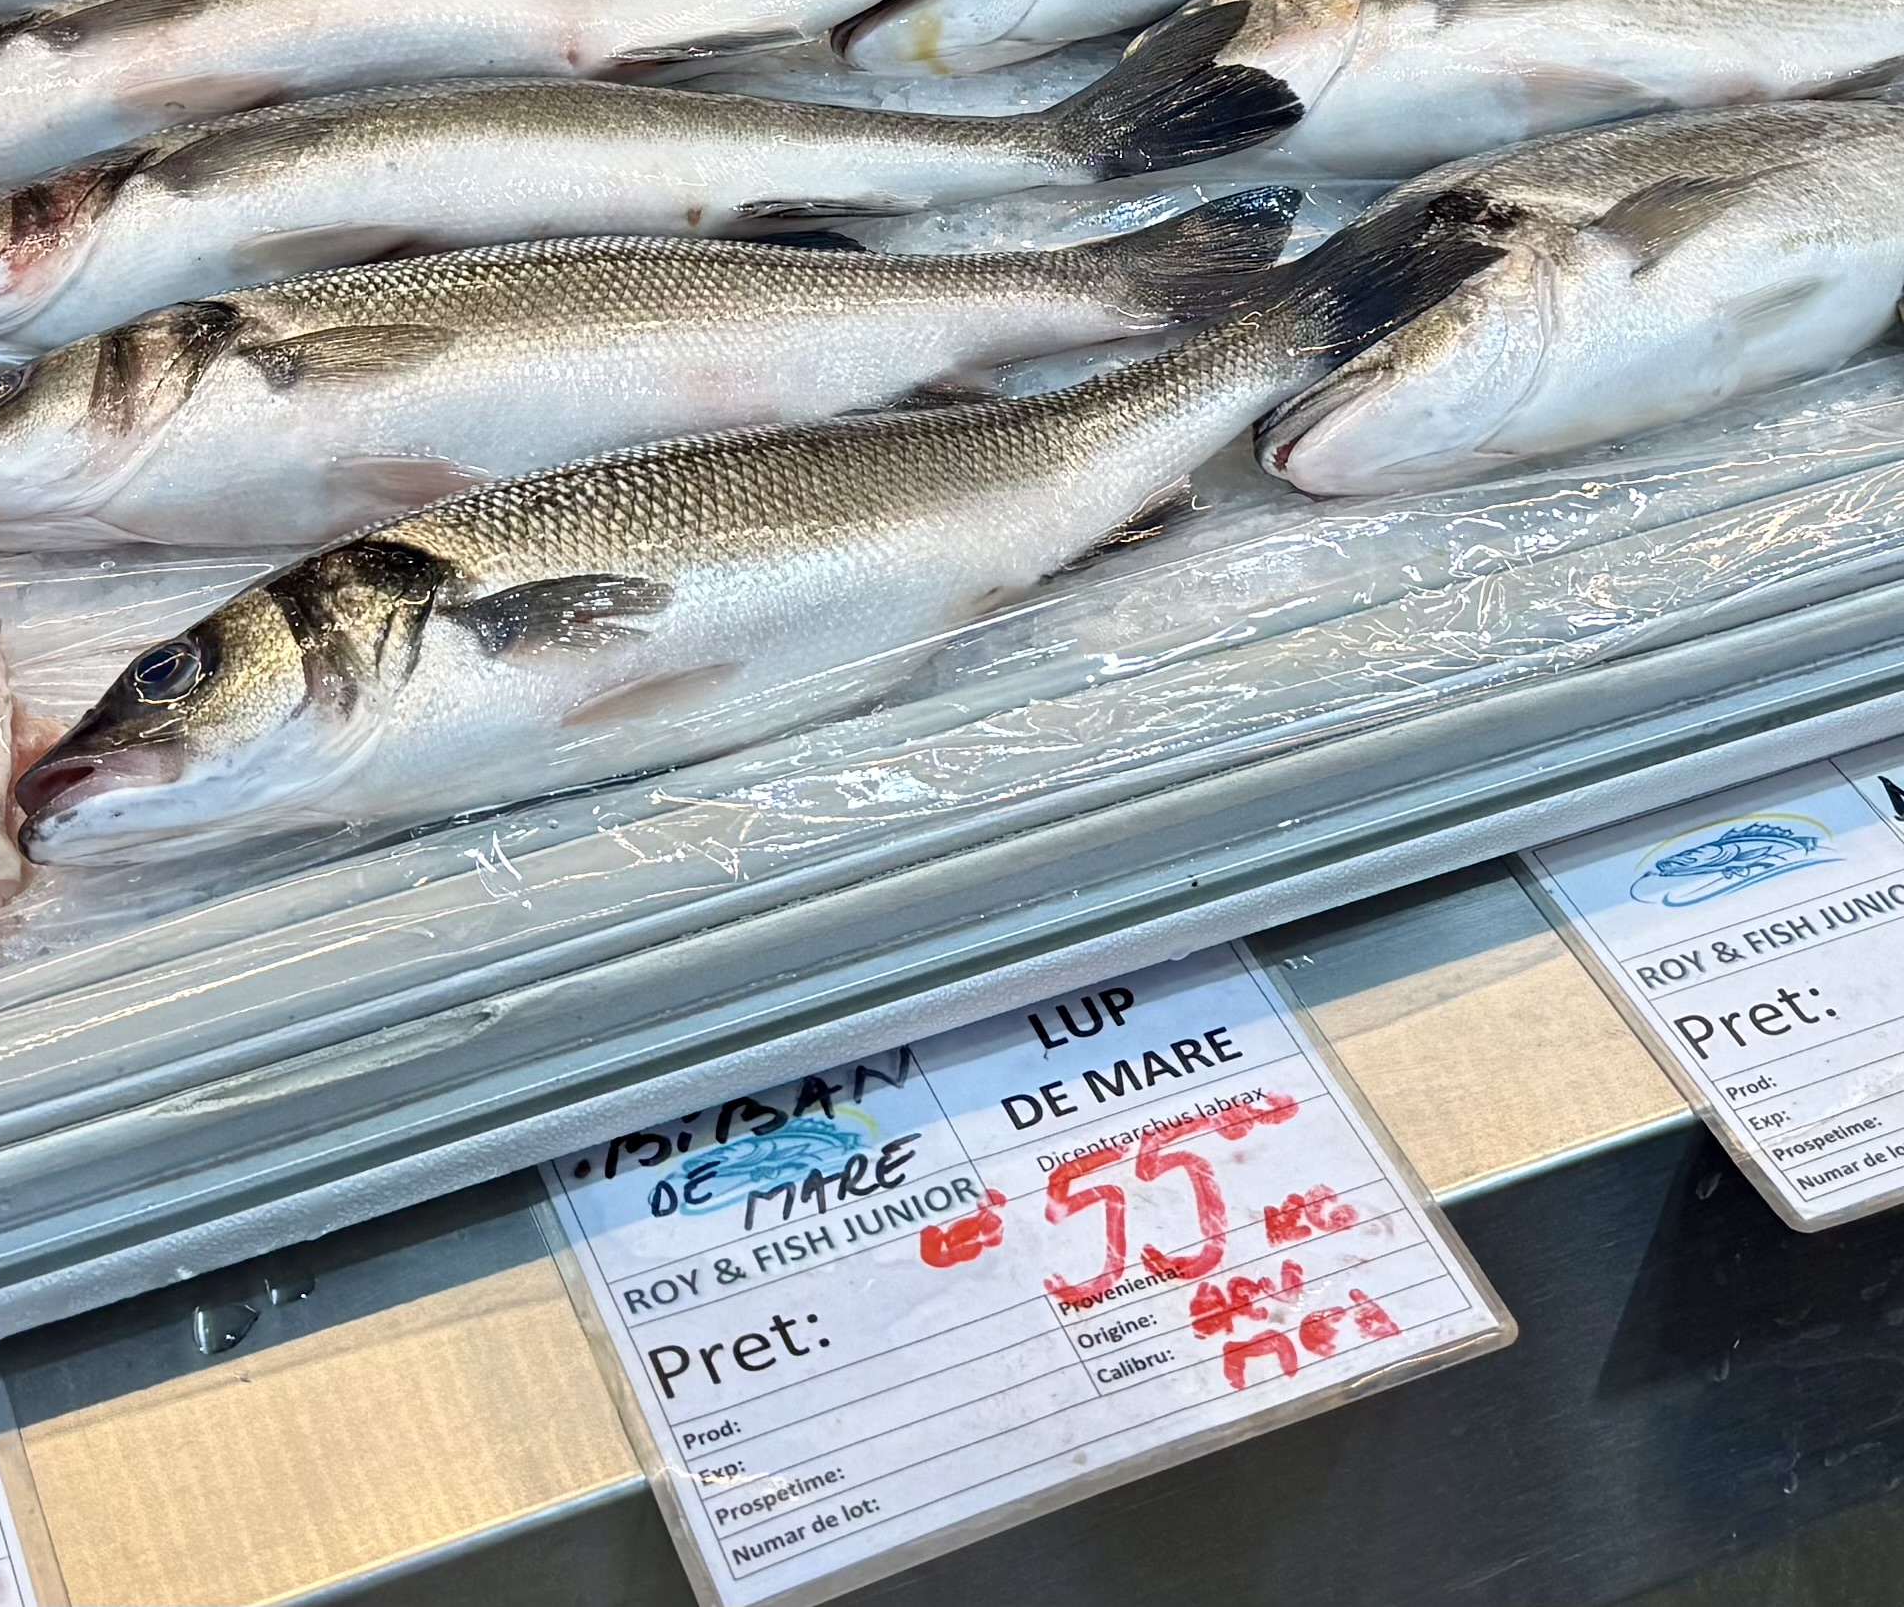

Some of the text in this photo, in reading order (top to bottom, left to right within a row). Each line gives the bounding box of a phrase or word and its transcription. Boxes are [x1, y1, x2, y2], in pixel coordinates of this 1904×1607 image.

[1636, 950, 1707, 990] ROY
[1711, 941, 1746, 965] &
[1743, 915, 1820, 954] FISH
[1027, 986, 1135, 1050] LUP
[1674, 987, 1837, 1060] Pret:
[1000, 1026, 1243, 1131] DE MARE
[1726, 1075, 1777, 1101] Prod:
[1036, 1087, 1268, 1173] Dicentrarchus labrax
[1749, 1109, 1791, 1131] Exp:
[1772, 1116, 1883, 1162] Prospetime:
[648, 1132, 922, 1231] DE MARE
[1796, 1159, 1860, 1191] Numar
[1863, 1150, 1888, 1168] de
[623, 1176, 984, 1314] ROY & FISH JUNIOR
[1058, 1265, 1185, 1316] Provenienta:
[648, 1313, 830, 1399] Pret:
[1077, 1314, 1158, 1349] Origine:
[1096, 1349, 1175, 1385] Calibru:
[682, 1420, 741, 1449] Prod:
[698, 1458, 746, 1486] Exp:
[715, 1467, 845, 1525] Prospetime:
[732, 1497, 881, 1566] Numar de lot:
